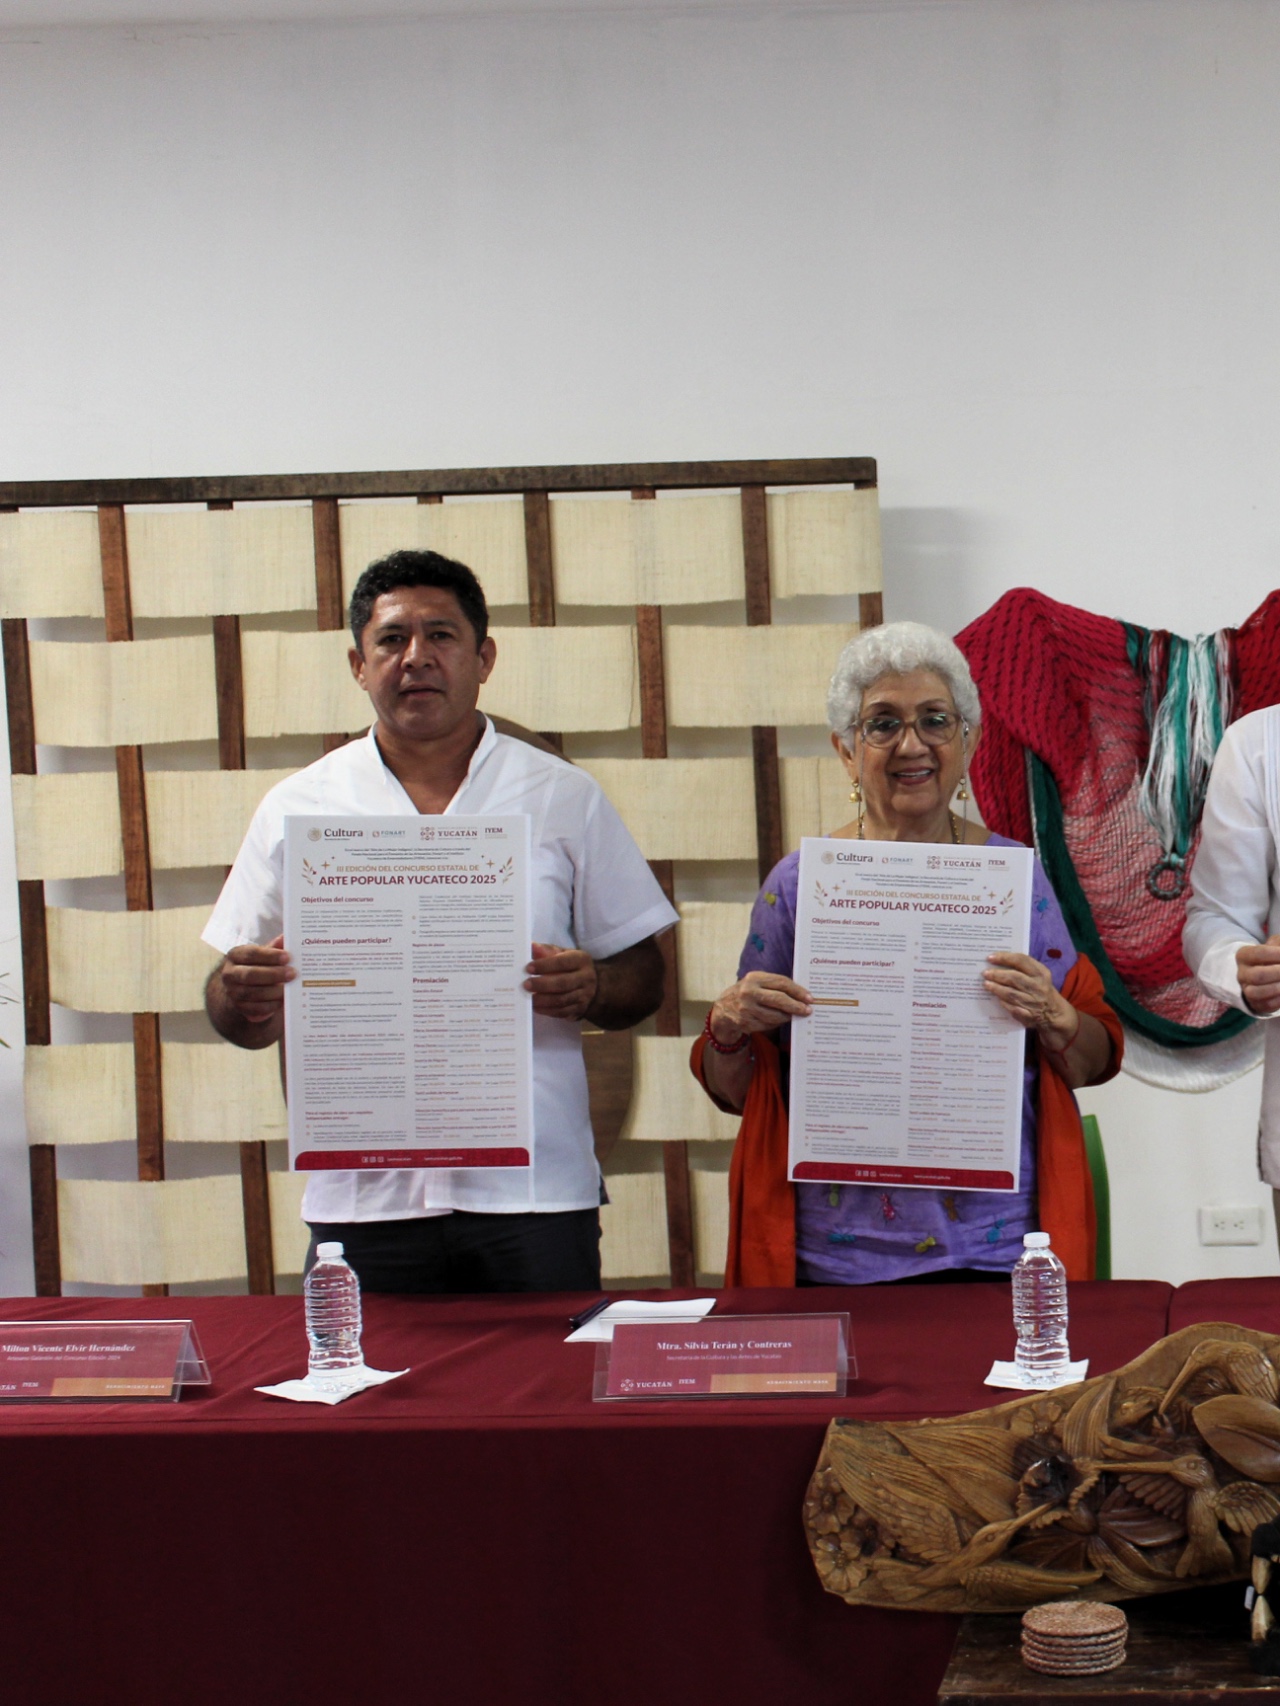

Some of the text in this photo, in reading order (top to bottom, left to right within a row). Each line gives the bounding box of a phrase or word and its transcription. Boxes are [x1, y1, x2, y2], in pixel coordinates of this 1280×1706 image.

[324, 828, 363, 837] Cultura
[836, 852, 873, 863] Cultura
[319, 874, 496, 886] ARTE POPULAR YUCATECO 2025
[829, 899, 996, 915] ARTE POPULAR YUCATECO 2025
[812, 918, 840, 926] Objetivos
[301, 937, 331, 945] ¿Quiénes
[810, 958, 837, 966] ¿Quiénes
[89, 1344, 136, 1352] Hernández
[712, 1341, 737, 1349] Terán
